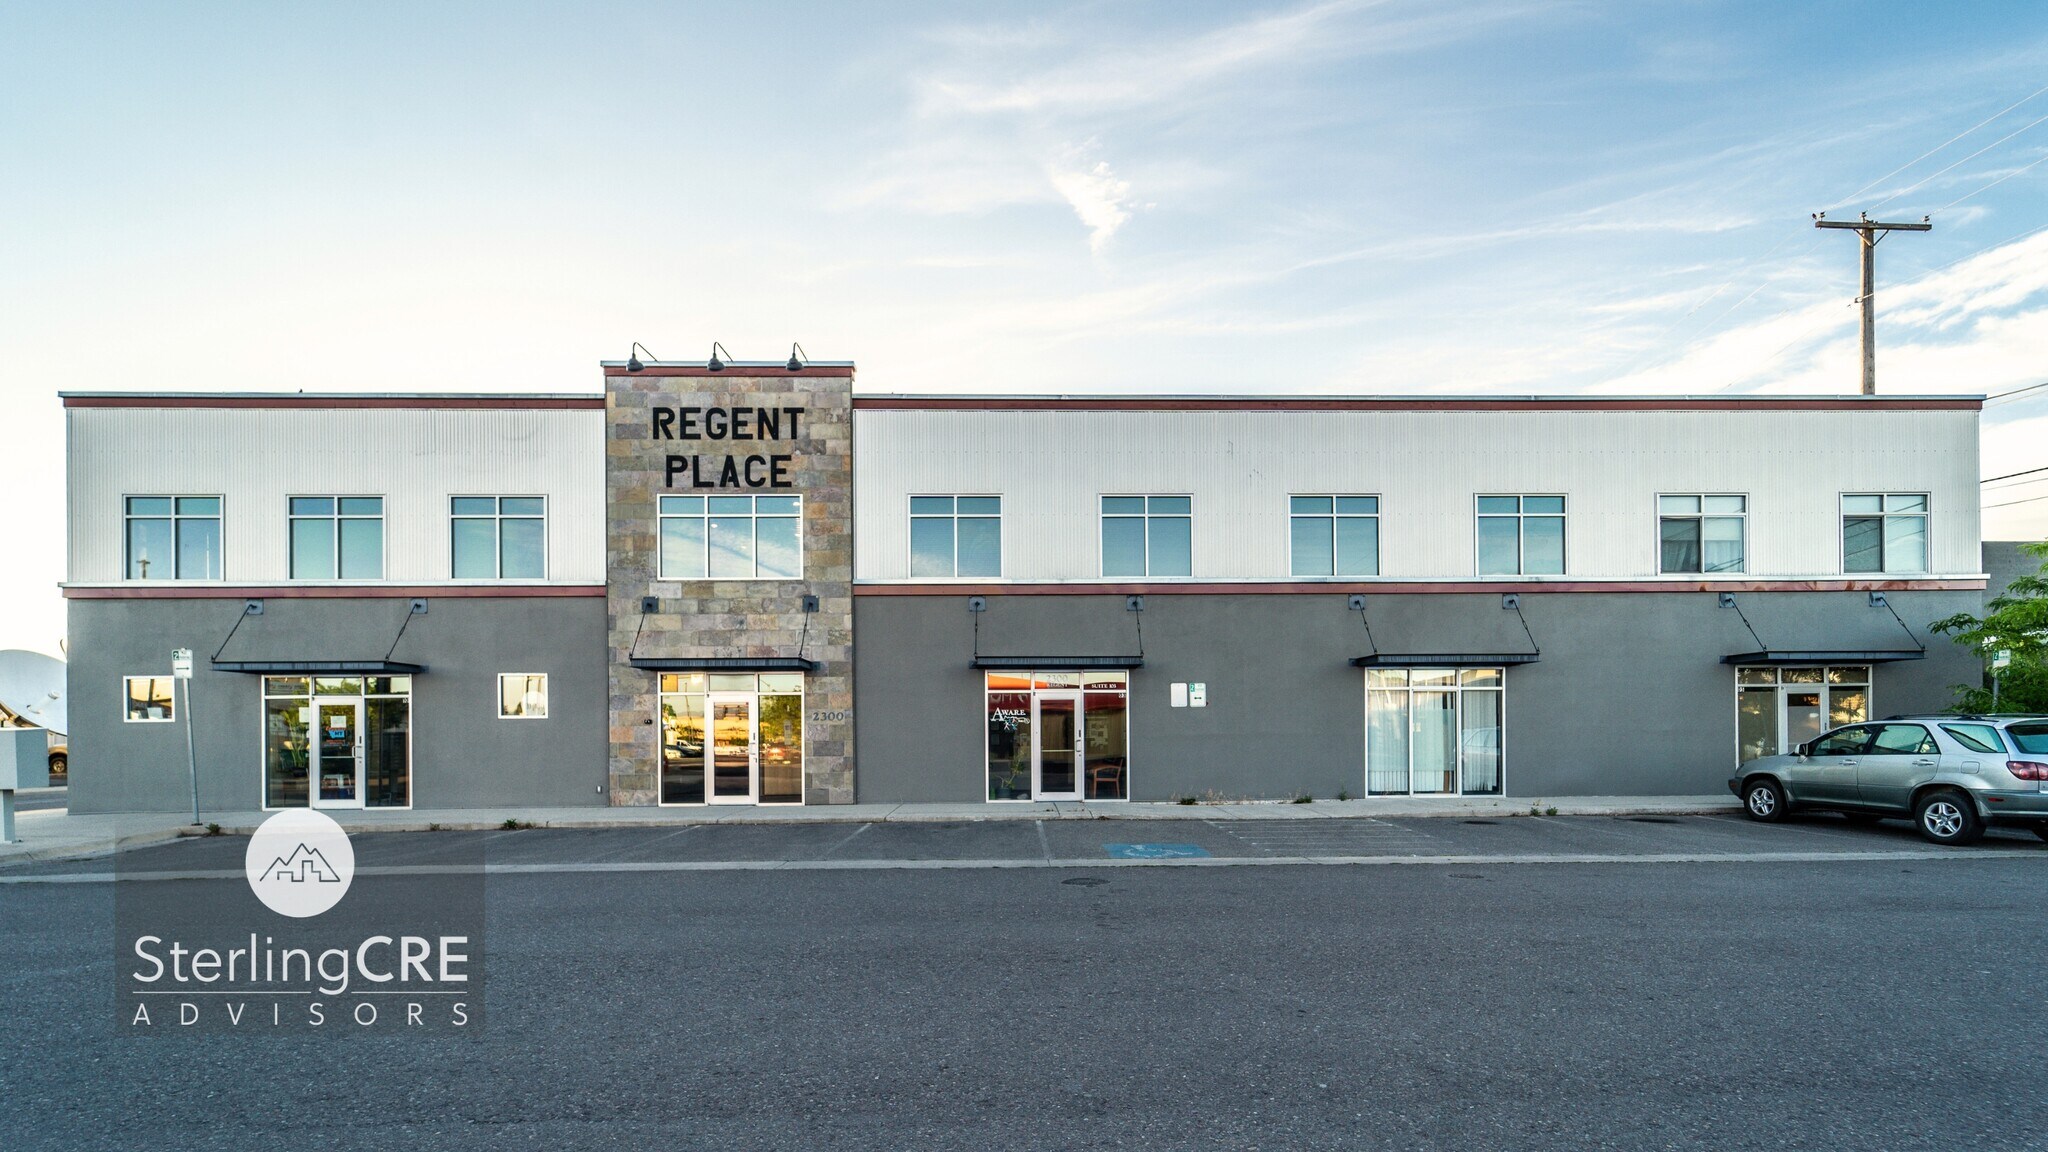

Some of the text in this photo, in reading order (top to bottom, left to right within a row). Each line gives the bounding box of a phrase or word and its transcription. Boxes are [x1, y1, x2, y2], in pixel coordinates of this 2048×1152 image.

[652, 407, 804, 440] REGENT
[666, 455, 792, 488] PLACE
[1047, 674, 1069, 682] 2300
[813, 711, 844, 721] 2300
